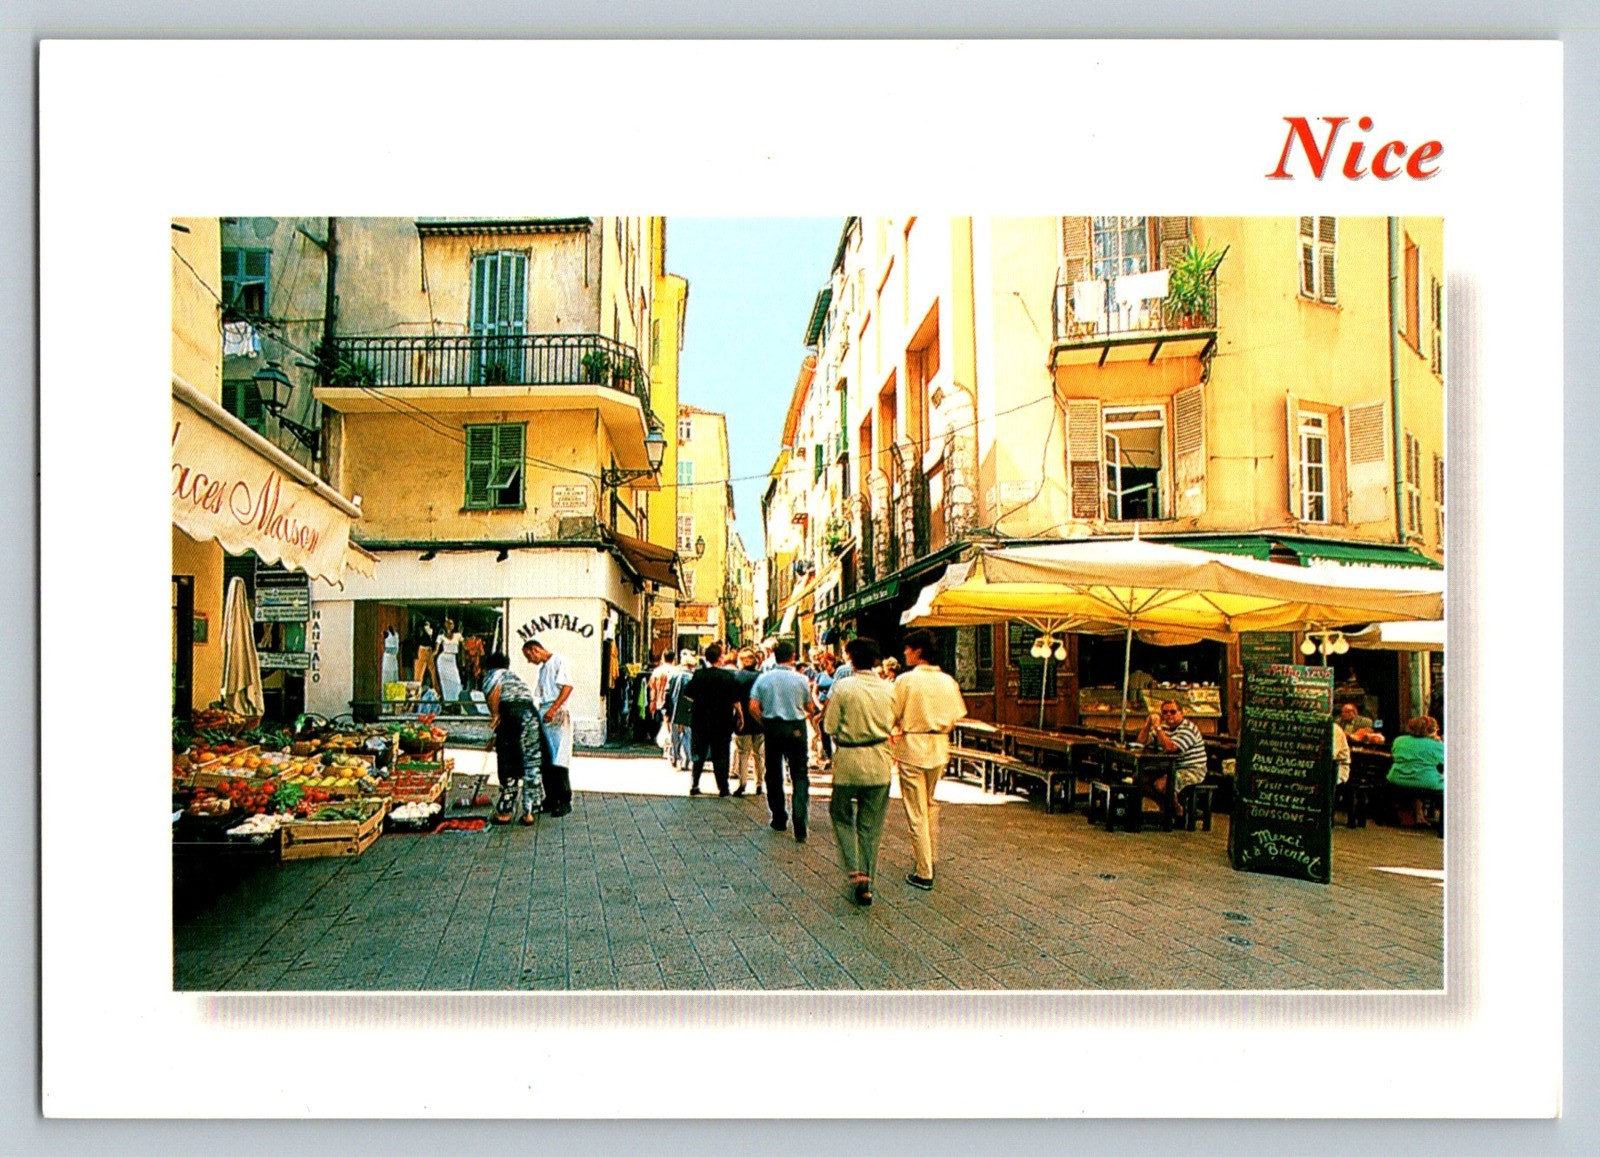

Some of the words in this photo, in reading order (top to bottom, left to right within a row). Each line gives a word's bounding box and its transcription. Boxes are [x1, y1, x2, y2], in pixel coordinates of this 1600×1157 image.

[229, 471, 319, 553] Maison
[516, 613, 594, 642] MANTALO
[1252, 753, 1274, 765] PAN
[1251, 829, 1303, 848] Merci
